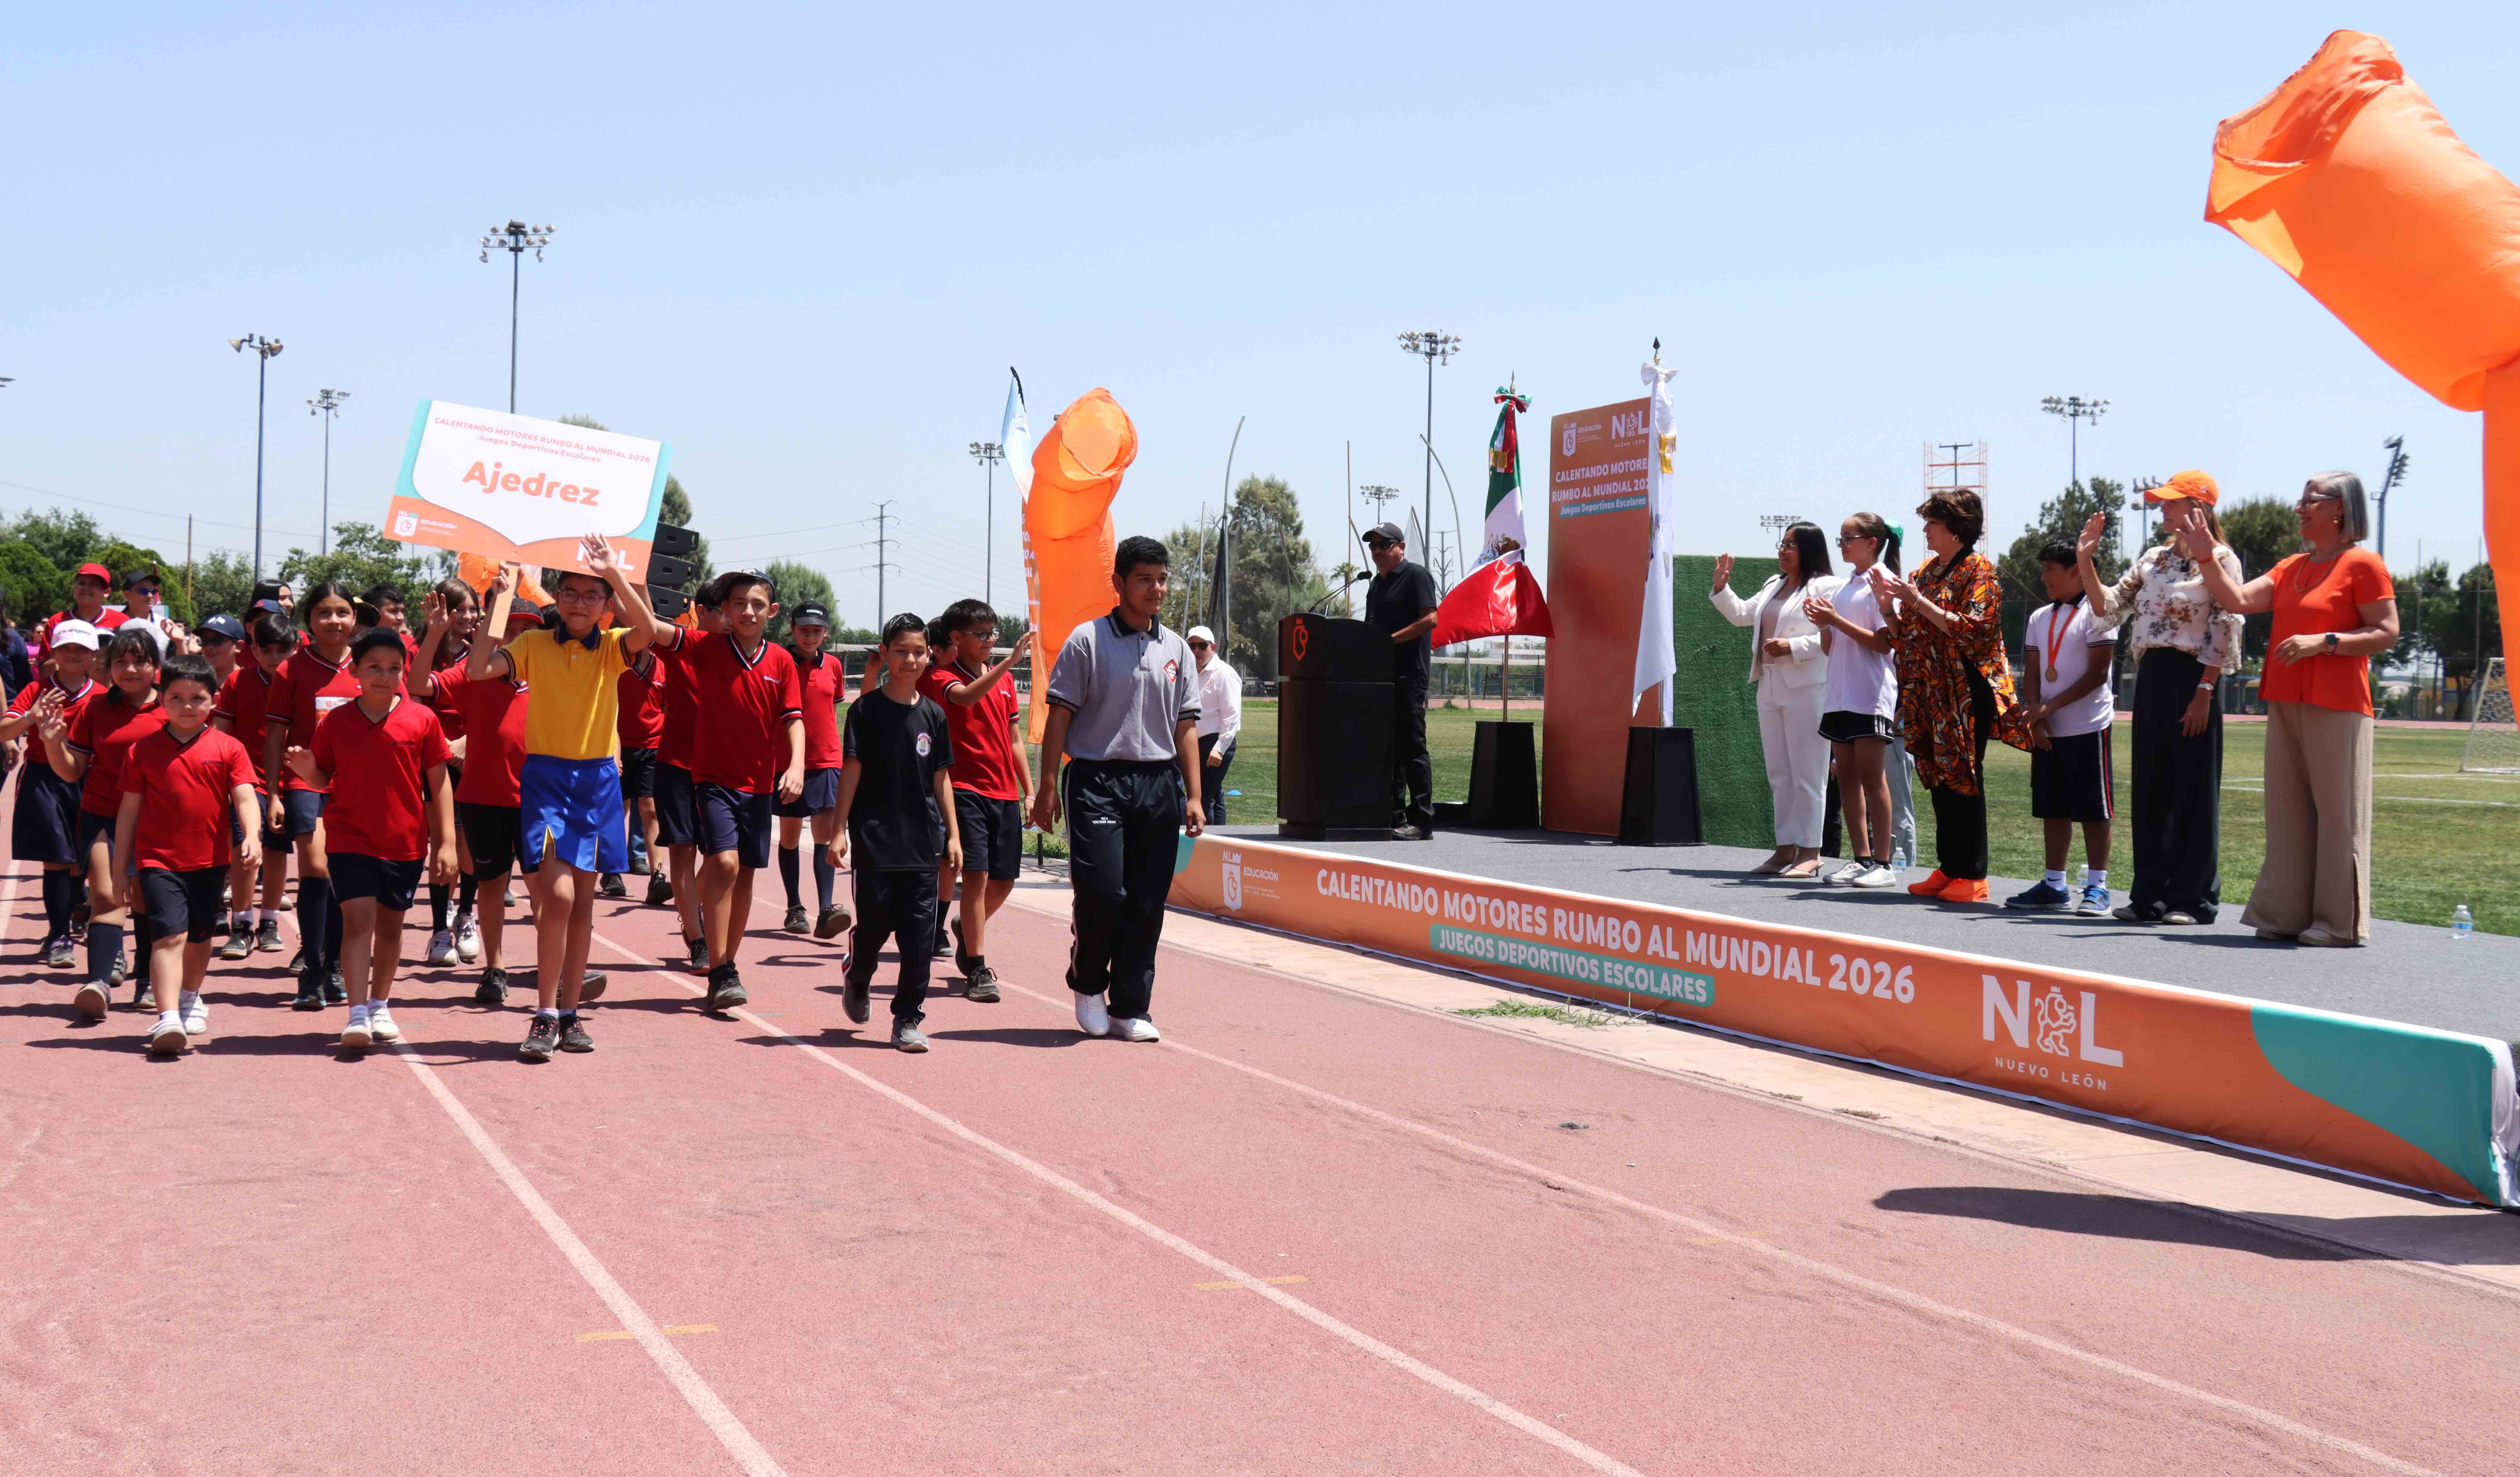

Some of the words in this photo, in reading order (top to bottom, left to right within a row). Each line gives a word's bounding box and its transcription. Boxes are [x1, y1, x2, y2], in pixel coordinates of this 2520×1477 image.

[434, 417, 494, 433] CALENTANDO
[495, 428, 538, 442] MOTORES
[540, 436, 572, 447] RUMBO
[586, 446, 626, 458] MUNDIAL
[628, 453, 651, 463] 2026
[478, 434, 509, 445] Juegos
[511, 440, 558, 455] Deportivos
[560, 449, 601, 463] Escolares
[462, 461, 601, 506] Ajedrez
[1556, 464, 1608, 483] CALENTANDO
[1610, 458, 1648, 475] MOTORE
[1552, 487, 1580, 502] RUMBO
[1582, 486, 1592, 498] AL
[1593, 481, 1632, 496] MUNDIAL
[1561, 506, 1580, 516] Juegos
[1582, 500, 1614, 513] Deportivos
[1616, 496, 1646, 508] Escolares
[1243, 866, 1279, 881] EDUCACIÓN
[1317, 869, 1438, 916] CALENTANDO
[1444, 890, 1547, 936] MOTORES
[1553, 908, 1641, 953] RUMBO
[1647, 924, 1680, 960] AL
[1686, 930, 1821, 986] MUNDIAL
[1828, 954, 1915, 1003] 2026
[1440, 929, 1495, 959] JUEGOS
[1498, 940, 1599, 981] DEPORTIVOS
[1603, 961, 1707, 1002] ESCOLARES
[1995, 1057, 2049, 1078] NUEVO
